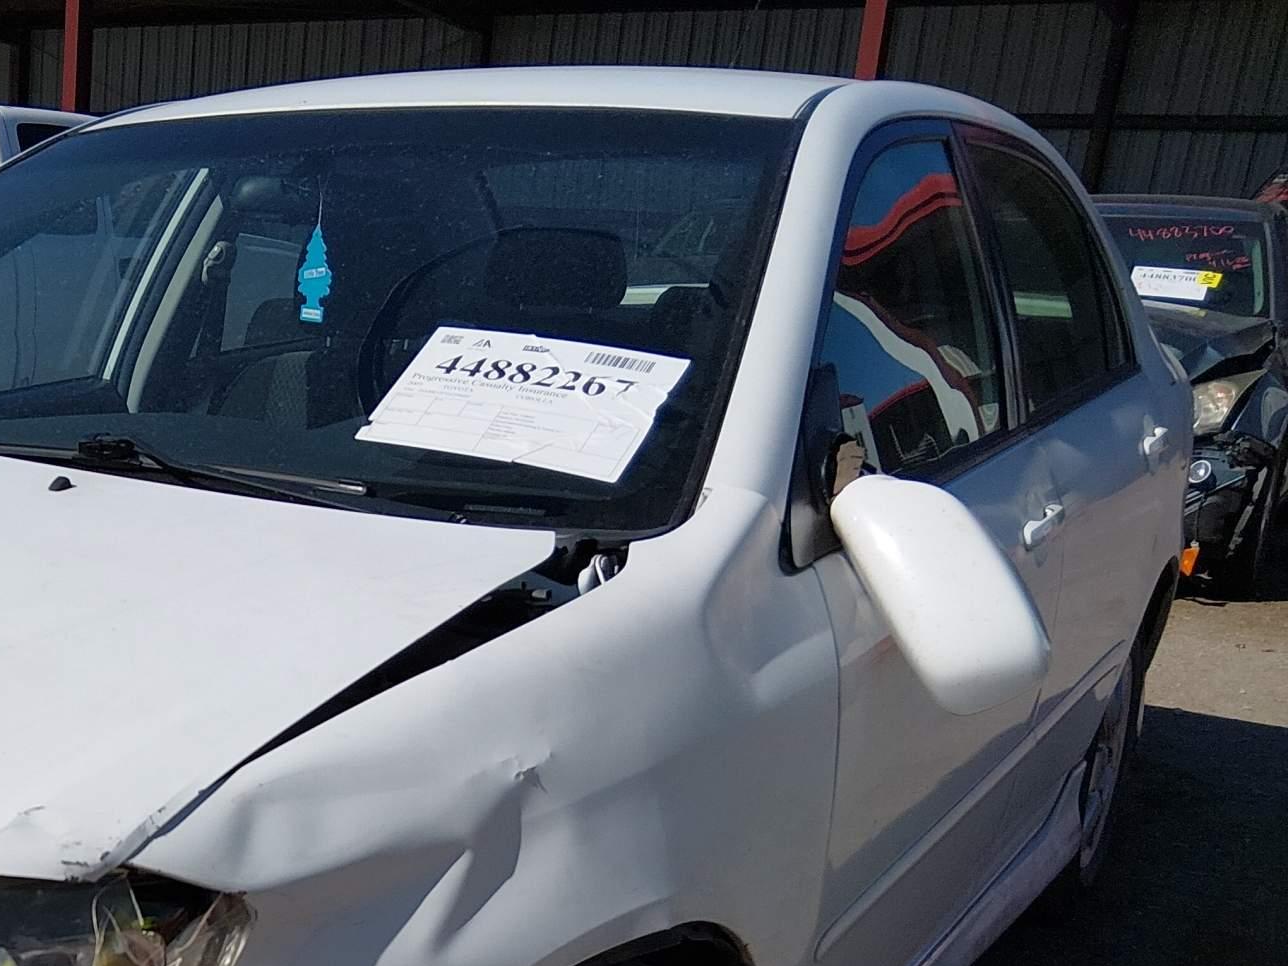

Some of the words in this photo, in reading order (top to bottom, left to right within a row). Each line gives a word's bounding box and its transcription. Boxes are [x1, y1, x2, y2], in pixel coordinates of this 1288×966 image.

[412, 373, 470, 385] Progressive
[472, 379, 515, 393] Casualty
[518, 385, 568, 399] Insurance
[434, 354, 639, 397] 44882267
